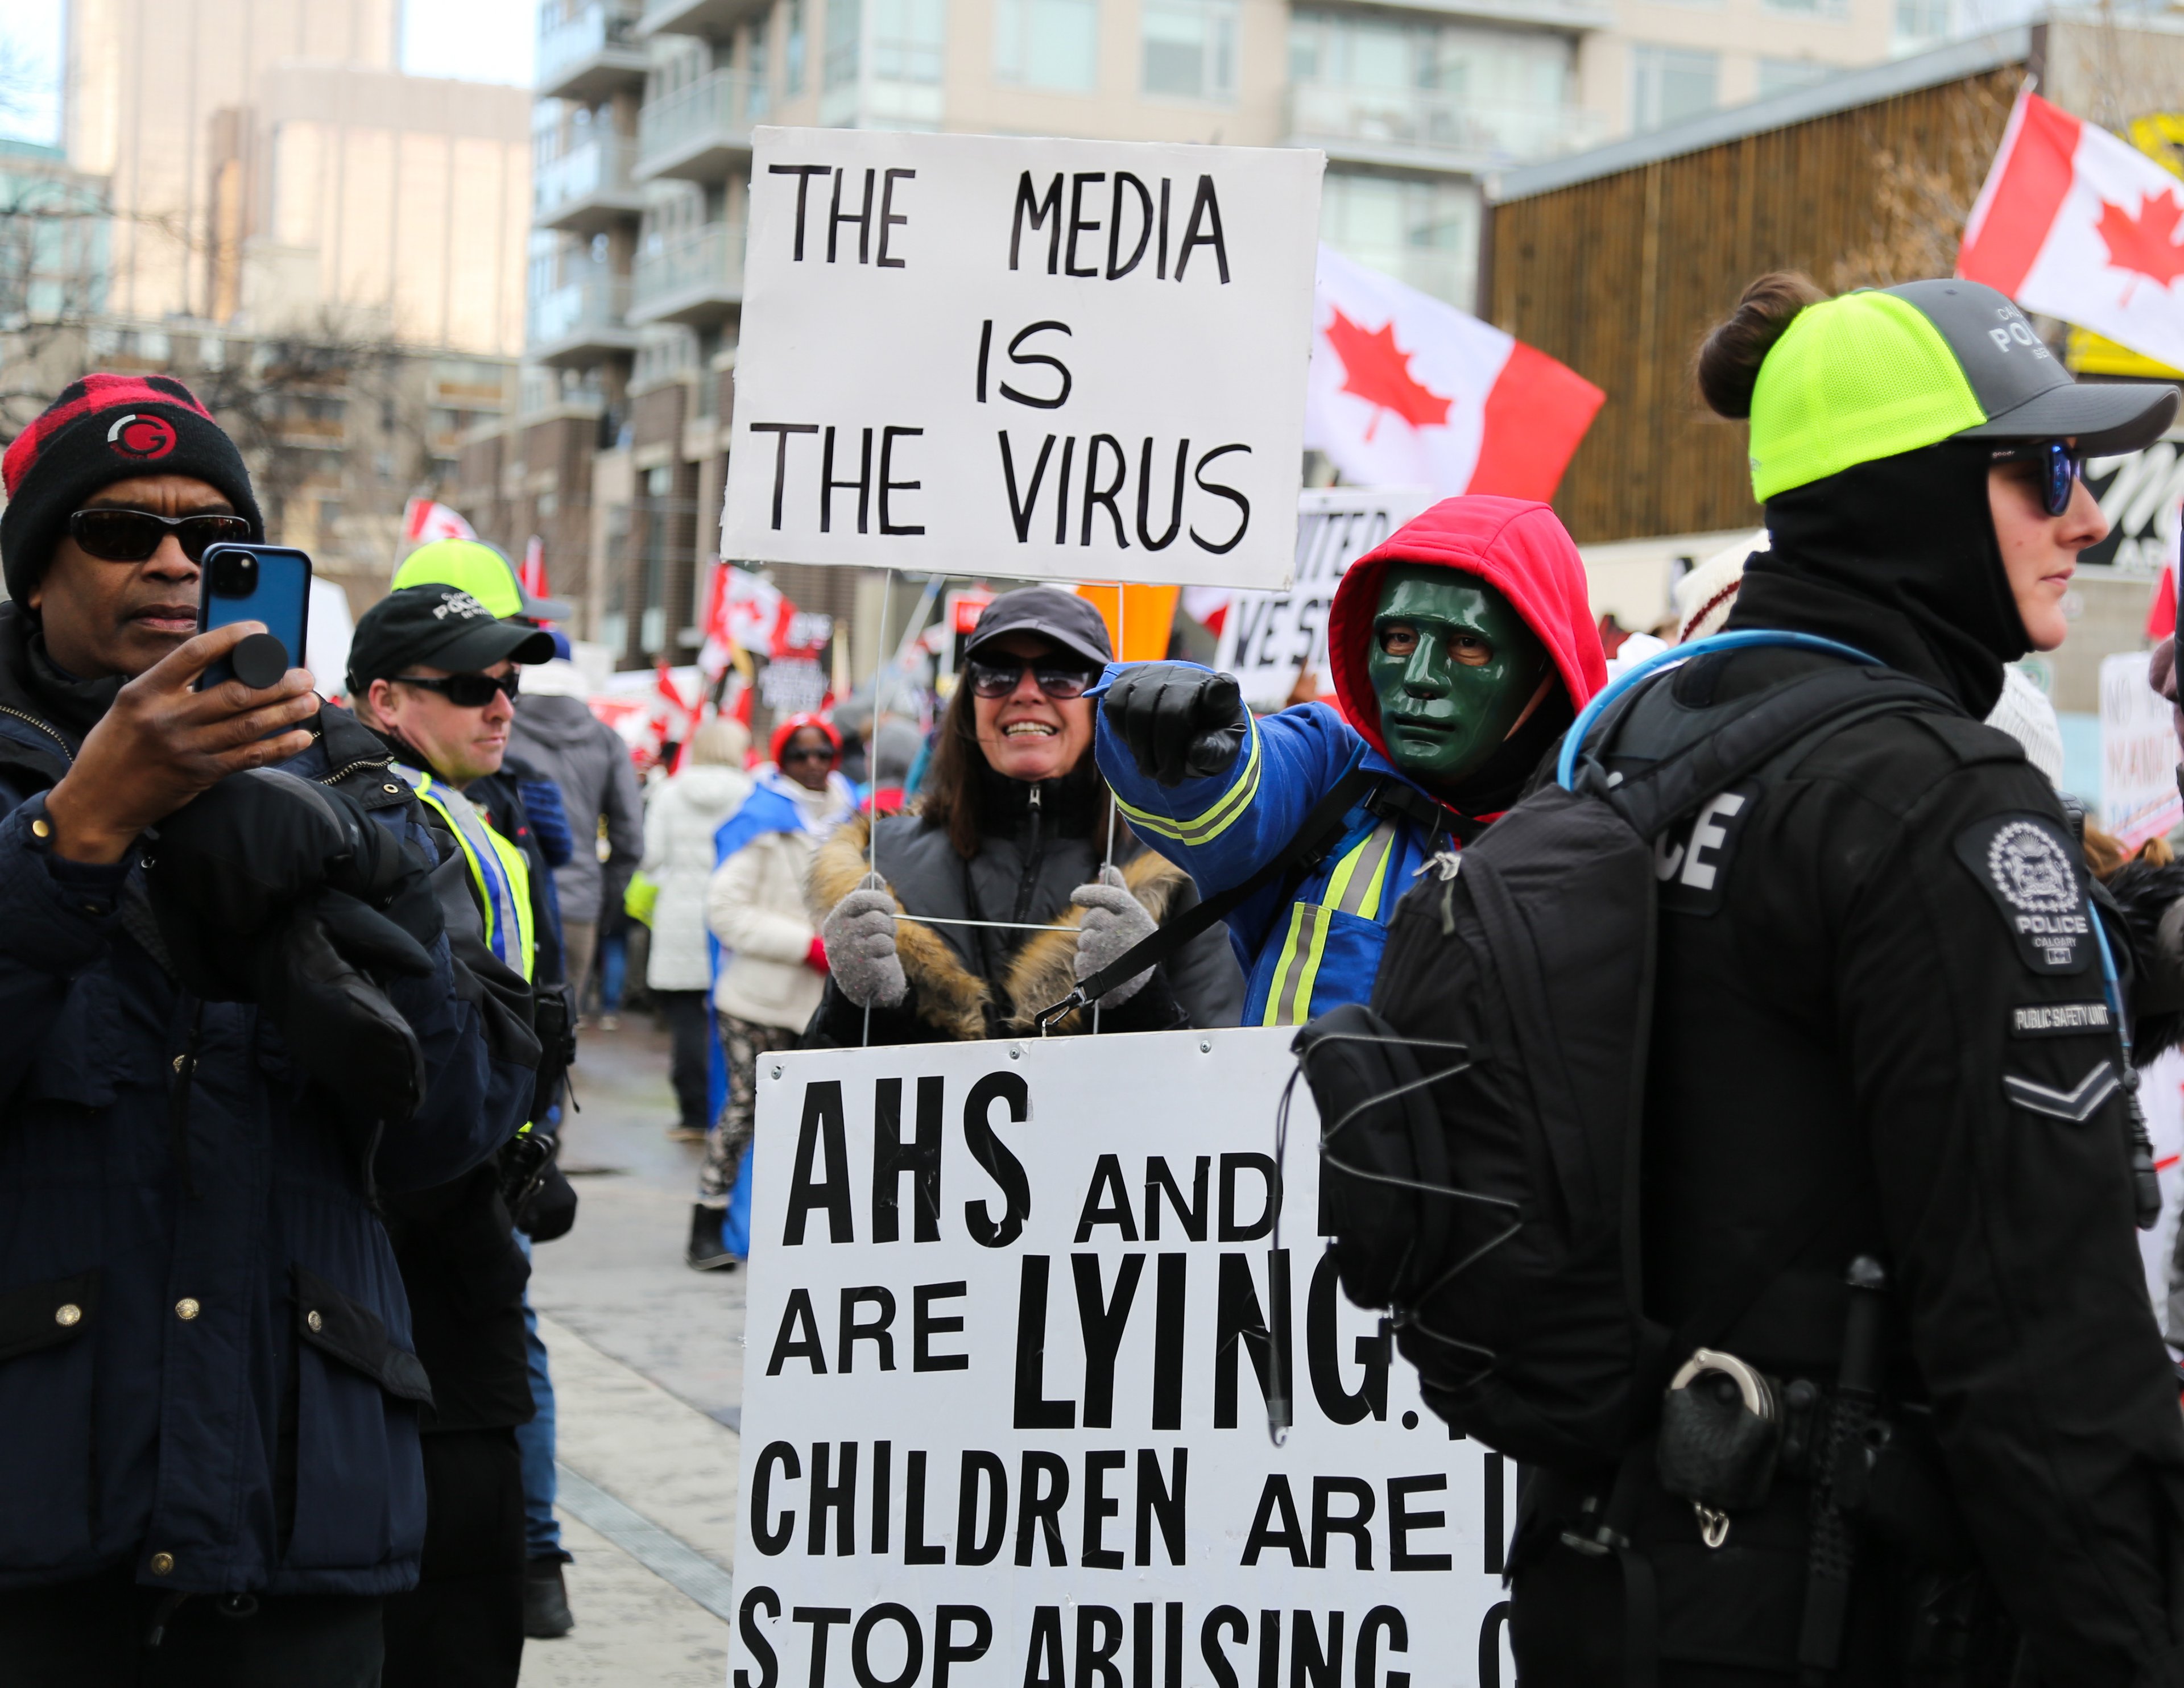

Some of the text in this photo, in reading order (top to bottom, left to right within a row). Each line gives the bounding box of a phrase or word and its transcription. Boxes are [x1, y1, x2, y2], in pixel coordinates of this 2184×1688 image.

[768, 164, 1230, 284] THE MEDIA
[977, 320, 1072, 409] IS
[750, 423, 1252, 555] THE VIRUS
[2016, 915, 2088, 933] POLICE
[2033, 937, 2076, 947] CALGARY
[2015, 1004, 2108, 1030] PUBLIC SAFETY UNIT
[782, 1071, 1031, 1248] AHS
[1073, 1152, 1284, 1243] AND
[766, 1248, 1419, 1430] ARE LYING.
[750, 1440, 1188, 1570] CHILDREN
[1240, 1473, 1452, 1572] ARE
[734, 1586, 993, 1688] STOP
[1023, 1602, 1410, 1688] ABUSING
